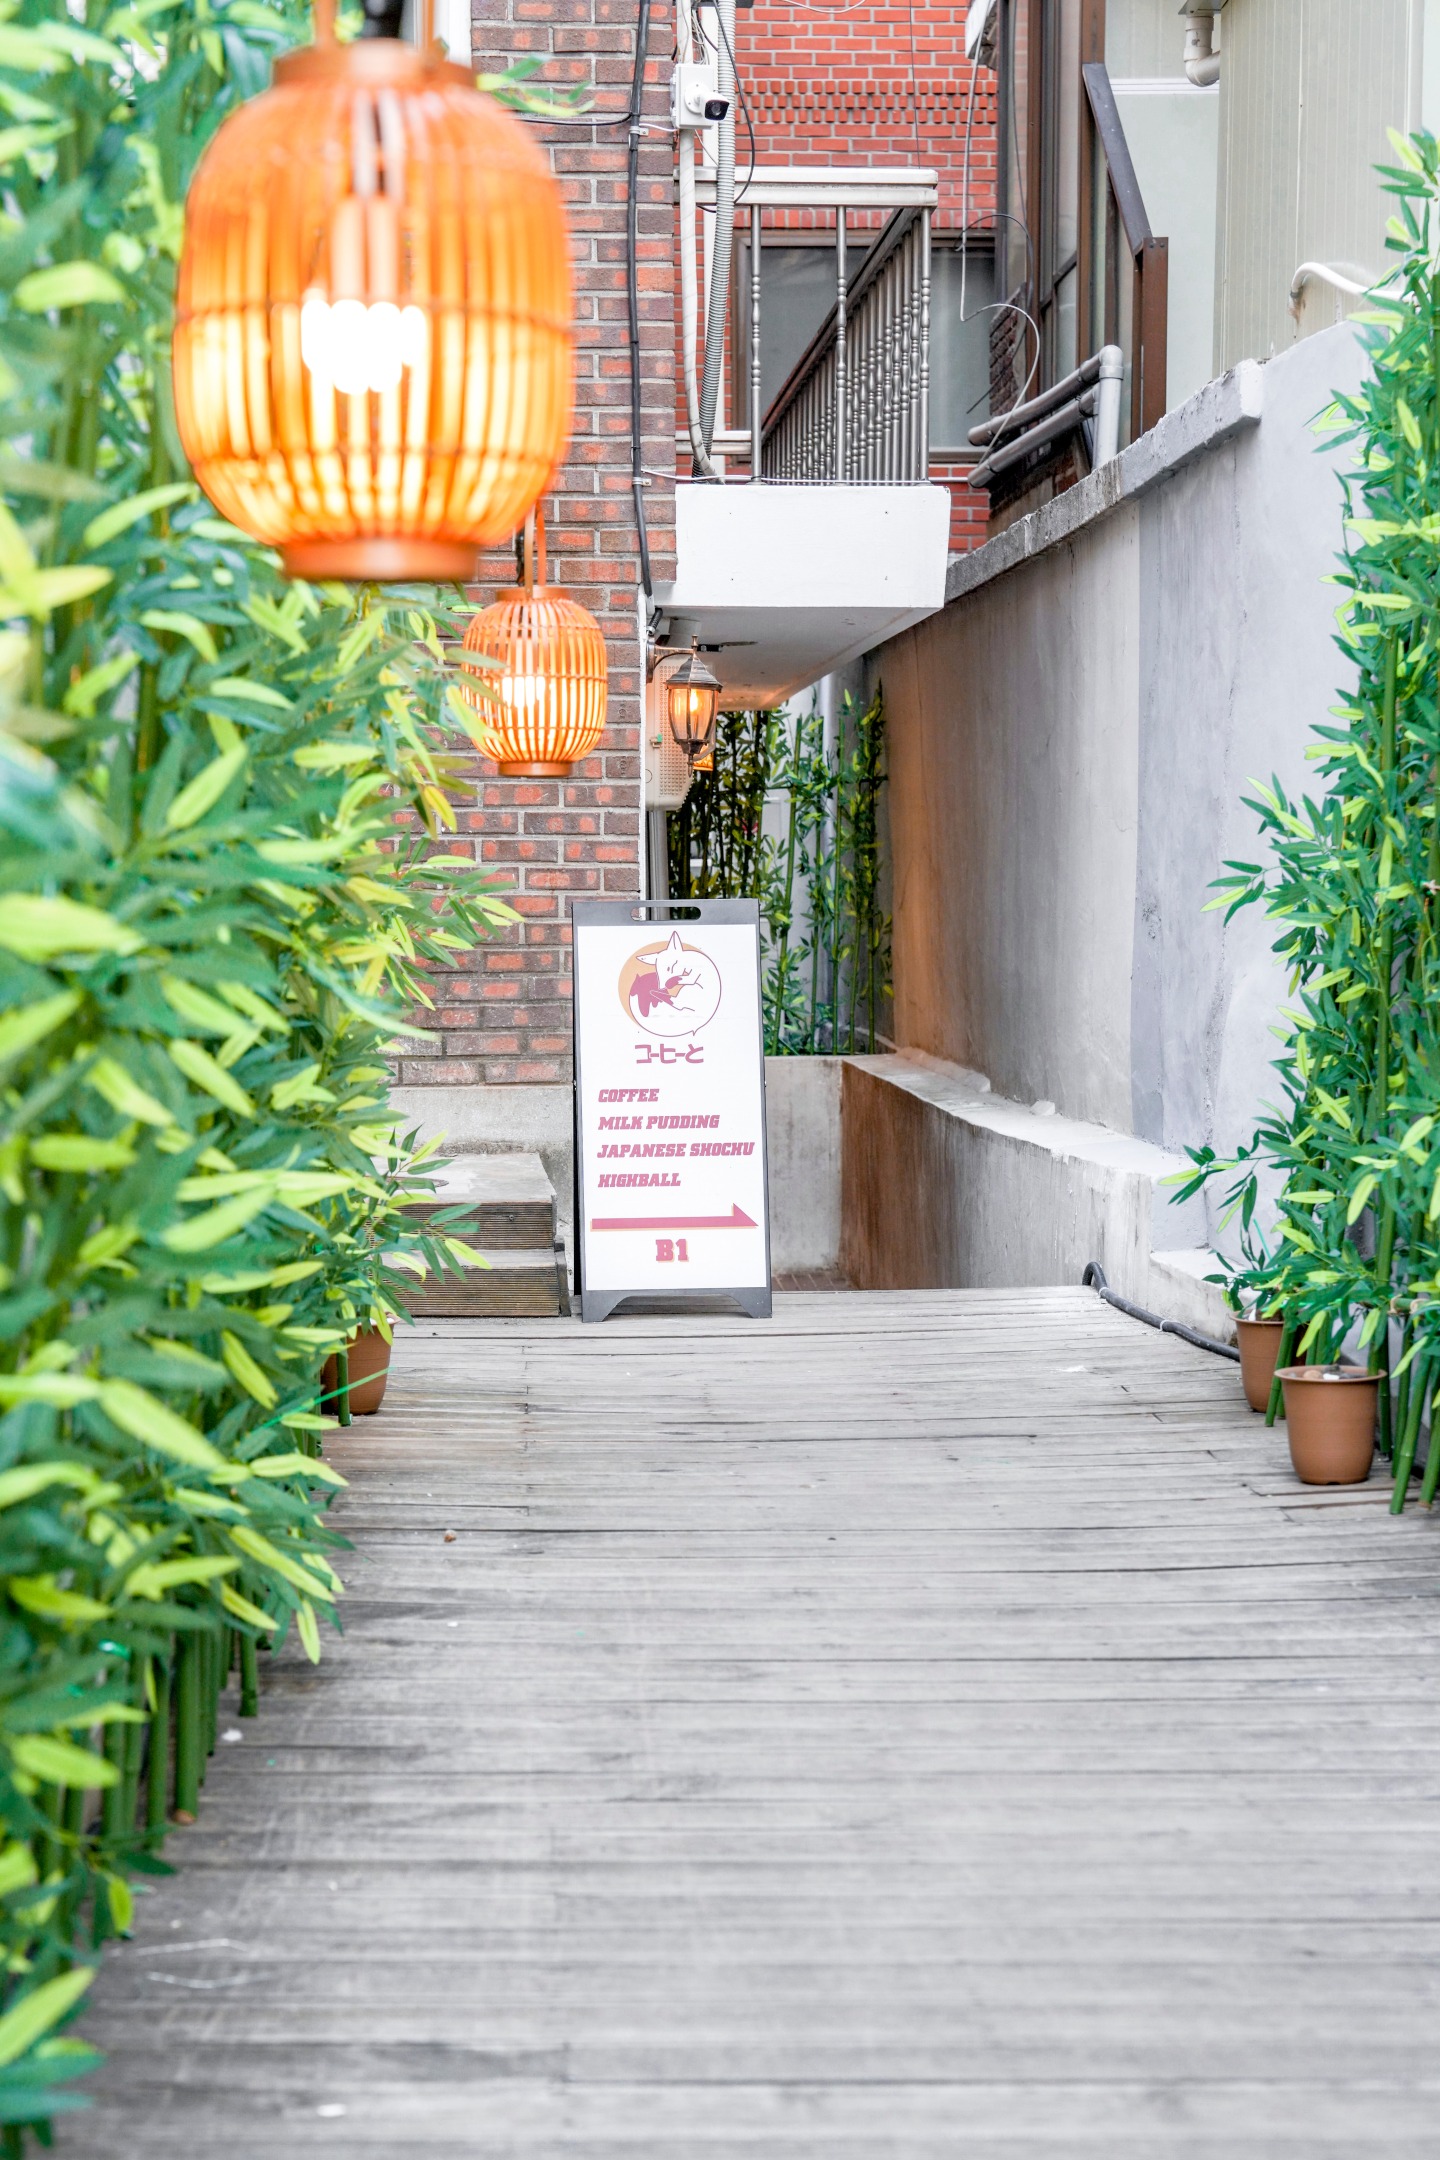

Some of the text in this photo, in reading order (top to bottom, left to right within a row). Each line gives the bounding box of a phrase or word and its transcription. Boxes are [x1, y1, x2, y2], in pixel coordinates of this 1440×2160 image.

[598, 1088, 660, 1103] COFFEE
[598, 1114, 720, 1130] MILK PUDDING
[597, 1141, 755, 1158] JAPANESE SHOCHU
[598, 1172, 681, 1188] HIGHBALL
[655, 1238, 689, 1262] B1
